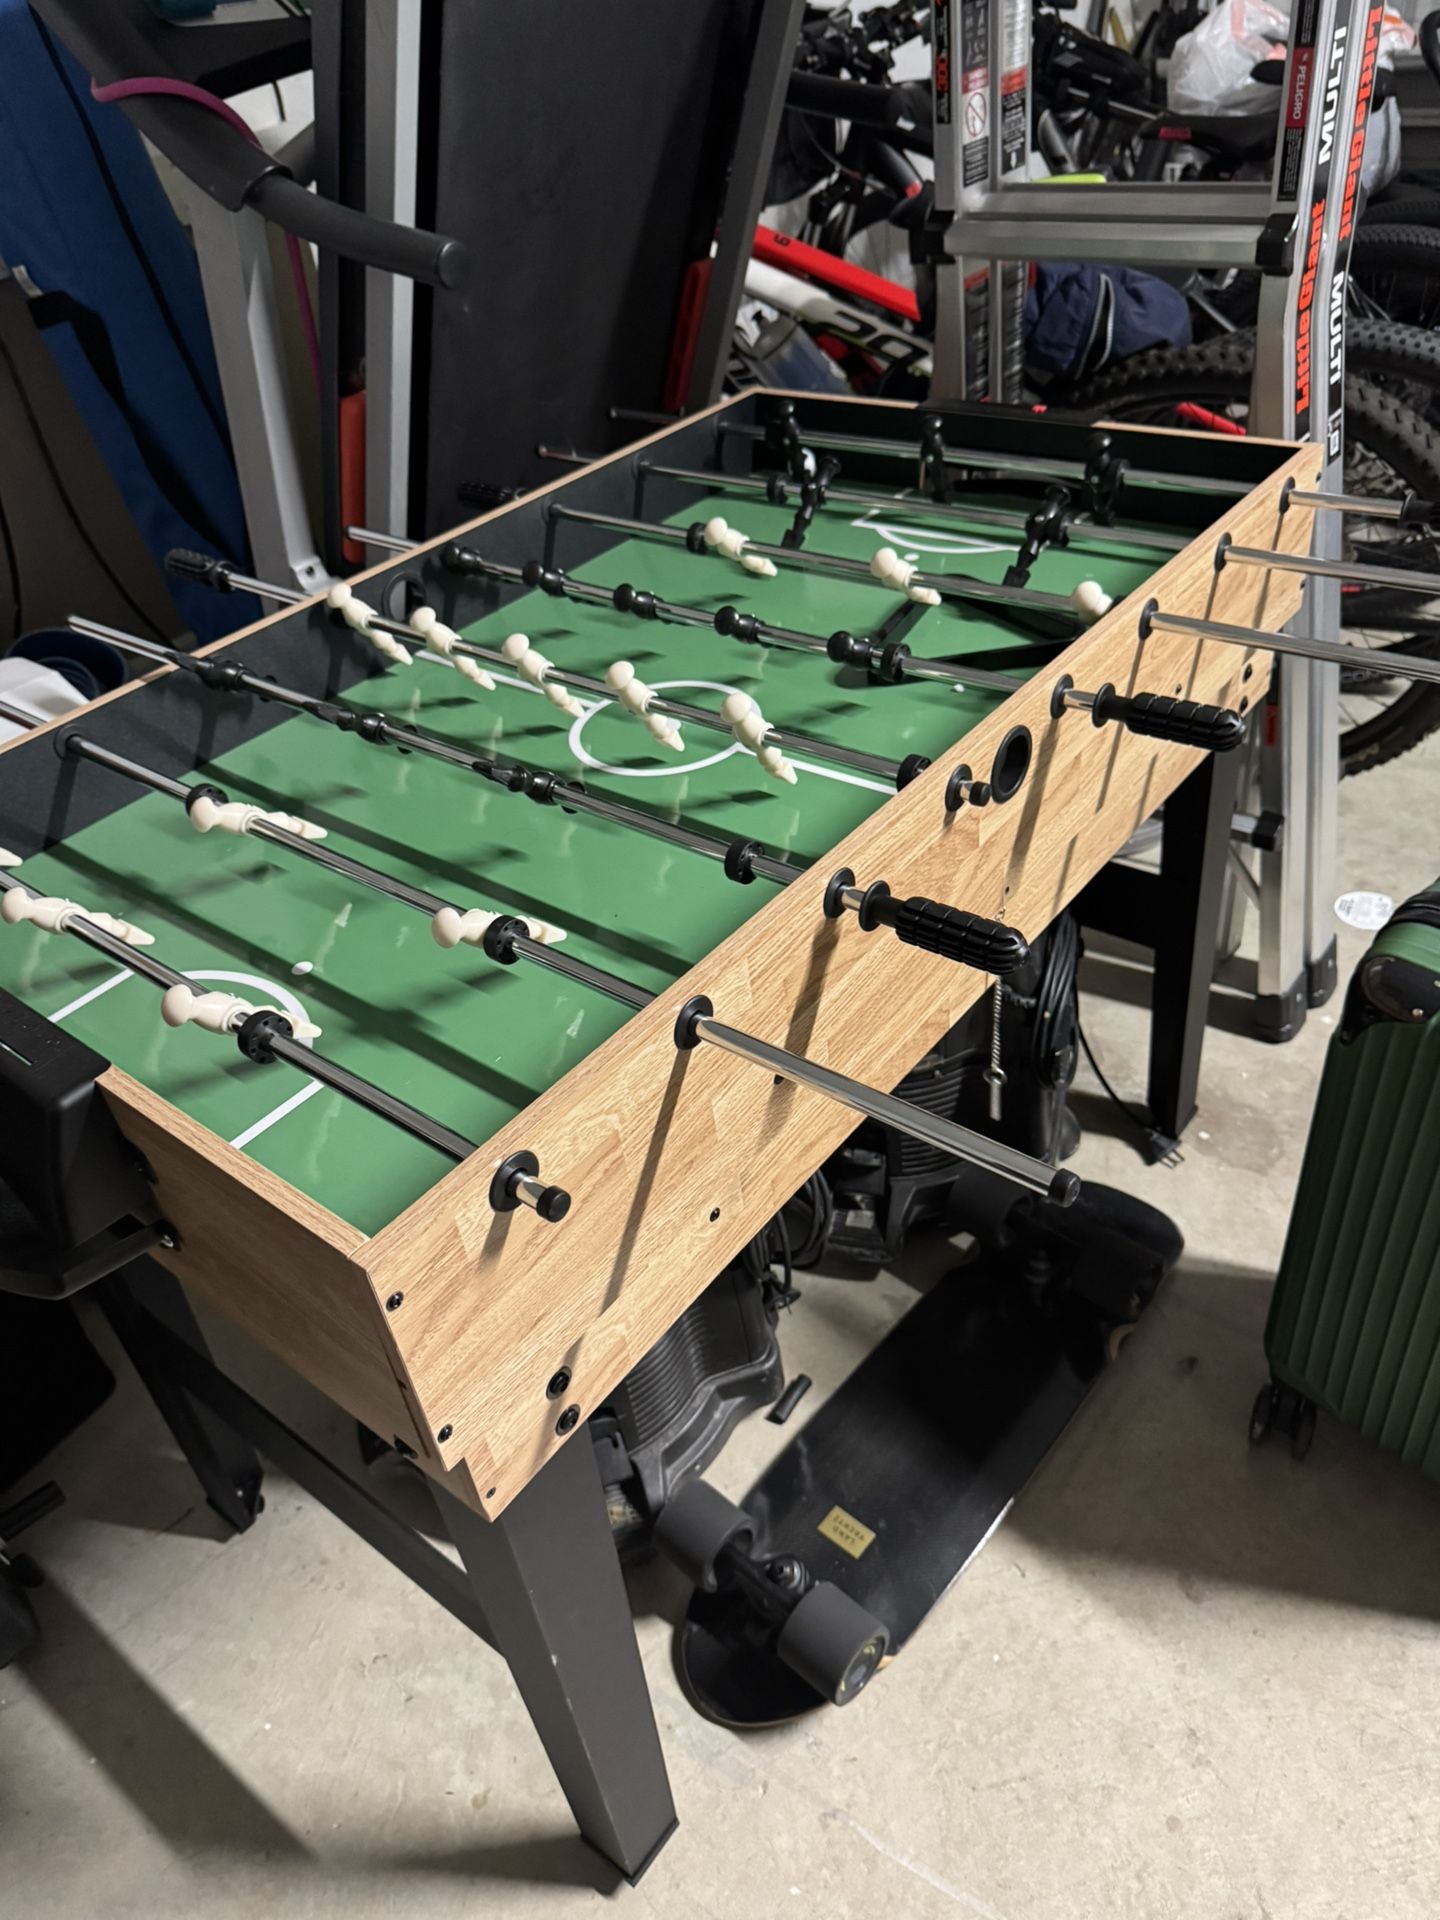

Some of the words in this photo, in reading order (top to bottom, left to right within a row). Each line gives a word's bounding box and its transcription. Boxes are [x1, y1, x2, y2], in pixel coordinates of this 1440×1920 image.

[1293, 65, 1307, 120] PELIGRO
[1318, 26, 1347, 165] MULTI
[1355, 6, 1383, 128] Little
[1338, 128, 1365, 241] Giant
[1298, 198, 1325, 312] Giant
[1296, 311, 1310, 414] Little
[1330, 271, 1345, 384] MULTI
